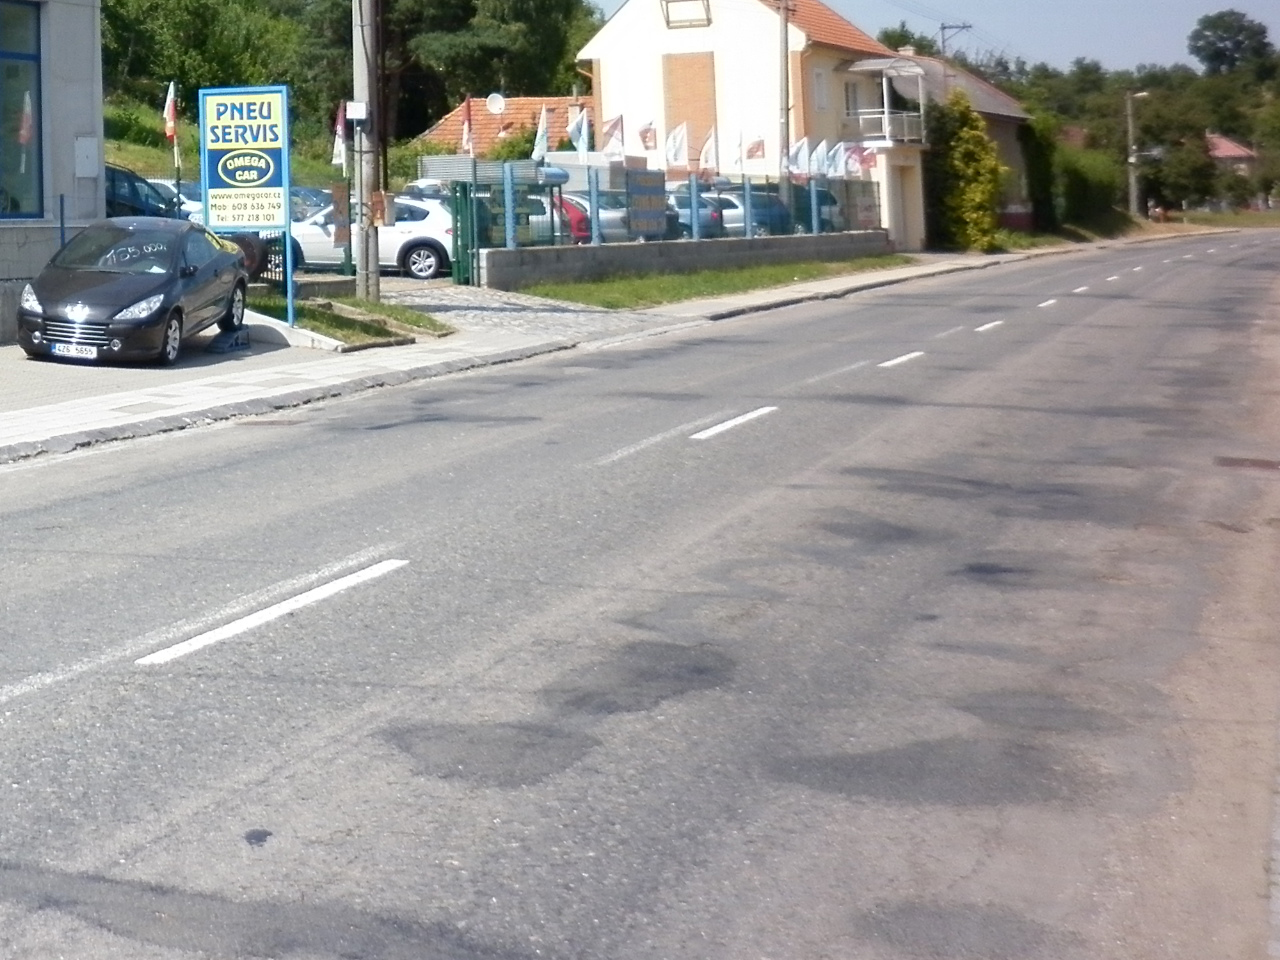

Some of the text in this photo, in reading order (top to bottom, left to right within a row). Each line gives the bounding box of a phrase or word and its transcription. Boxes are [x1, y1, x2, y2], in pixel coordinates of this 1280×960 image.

[216, 101, 272, 121] PNEU
[210, 123, 279, 145] SERVIS
[226, 156, 266, 170] OMEGA
[235, 170, 258, 181] CAR
[210, 192, 281, 201] www.omegacar.cz
[231, 203, 248, 211] 608
[250, 202, 265, 211] 636
[267, 202, 281, 210] 749
[216, 213, 275, 222] Tel: 577 218 101
